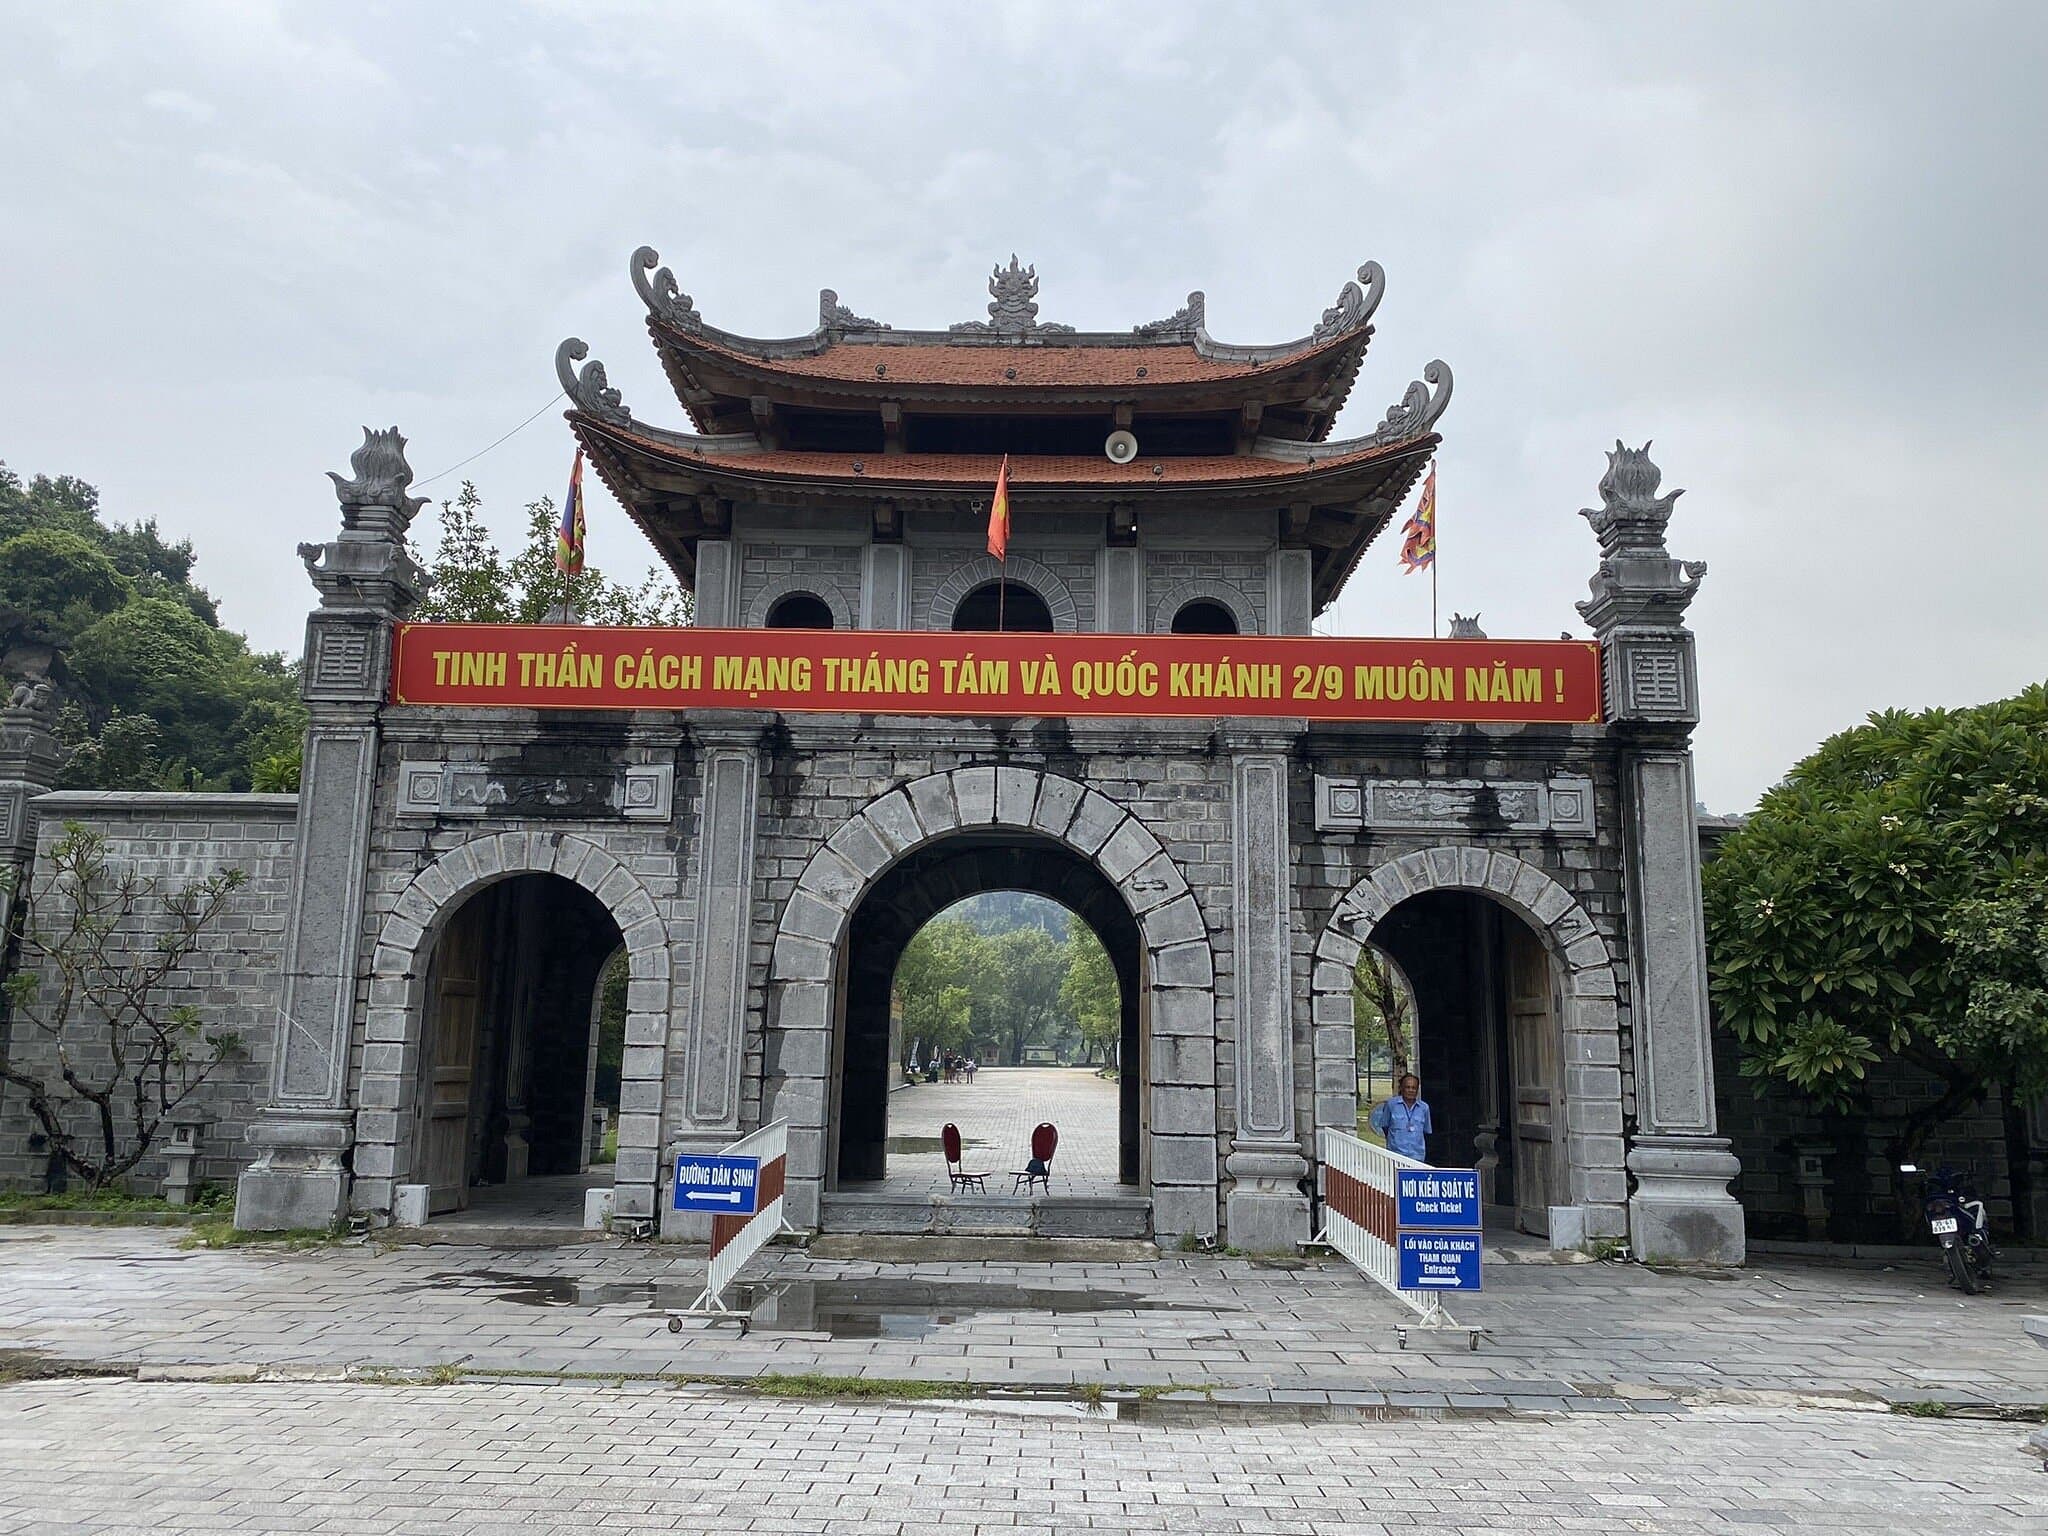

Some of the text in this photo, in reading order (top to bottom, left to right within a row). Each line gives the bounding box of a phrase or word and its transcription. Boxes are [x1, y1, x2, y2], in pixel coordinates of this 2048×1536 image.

[432, 641, 1564, 703] TINH THẦN CÁCH MẠNG THÁNG TÁM VÀ QUỐC KHÁNH 2/9 MUÔN NĂM !
[680, 1162, 754, 1187] ĐƯỜNG DÂN SINH
[1402, 1178, 1417, 1198] NƠI
[1418, 1174, 1440, 1198] KIỂM
[1441, 1178, 1462, 1199] SOÁT
[1415, 1201, 1462, 1214] Check Ticket
[1417, 1238, 1432, 1250] VÀO
[1433, 1238, 1449, 1251] CỦA
[1450, 1239, 1475, 1251] KHÁCH
[1419, 1253, 1462, 1264] THAM QUAN
[1424, 1264, 1456, 1274] Entrance
